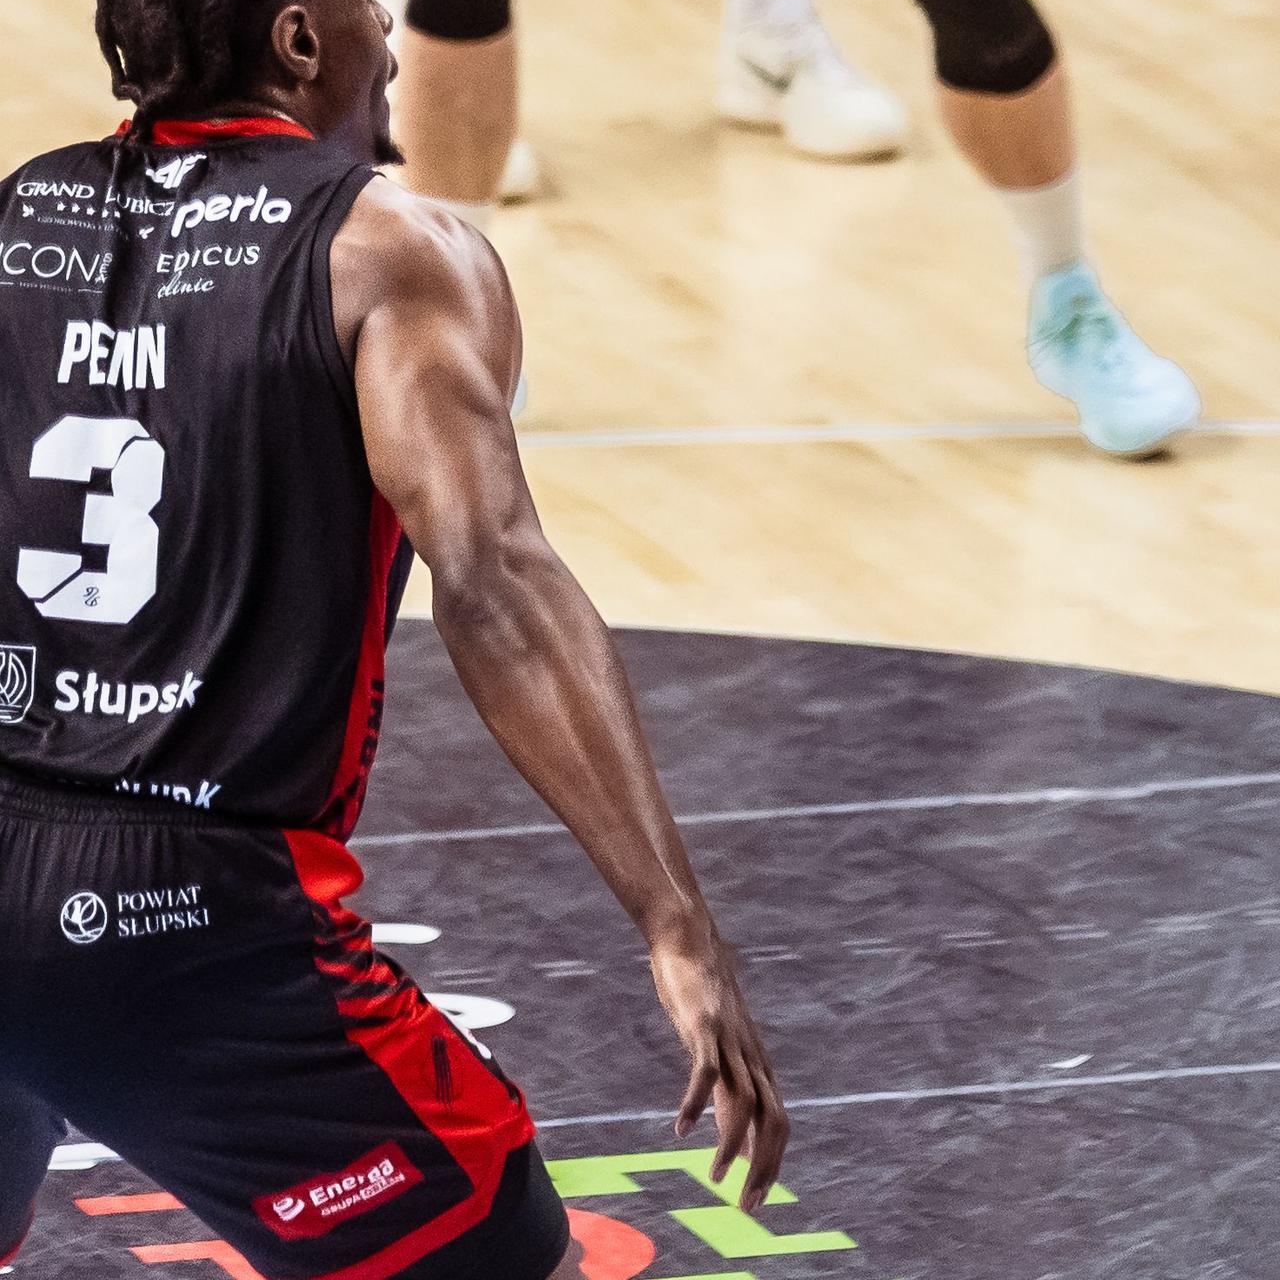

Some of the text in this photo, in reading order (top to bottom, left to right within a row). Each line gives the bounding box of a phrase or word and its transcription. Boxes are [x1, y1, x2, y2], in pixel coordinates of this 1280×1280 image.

[16, 180, 95, 200] GRAND
[157, 272, 215, 300] clinic
[57, 319, 166, 392] PENN
[16, 415, 166, 625] 3
[54, 670, 204, 724] Słupsk
[117, 885, 201, 913] POWIAT
